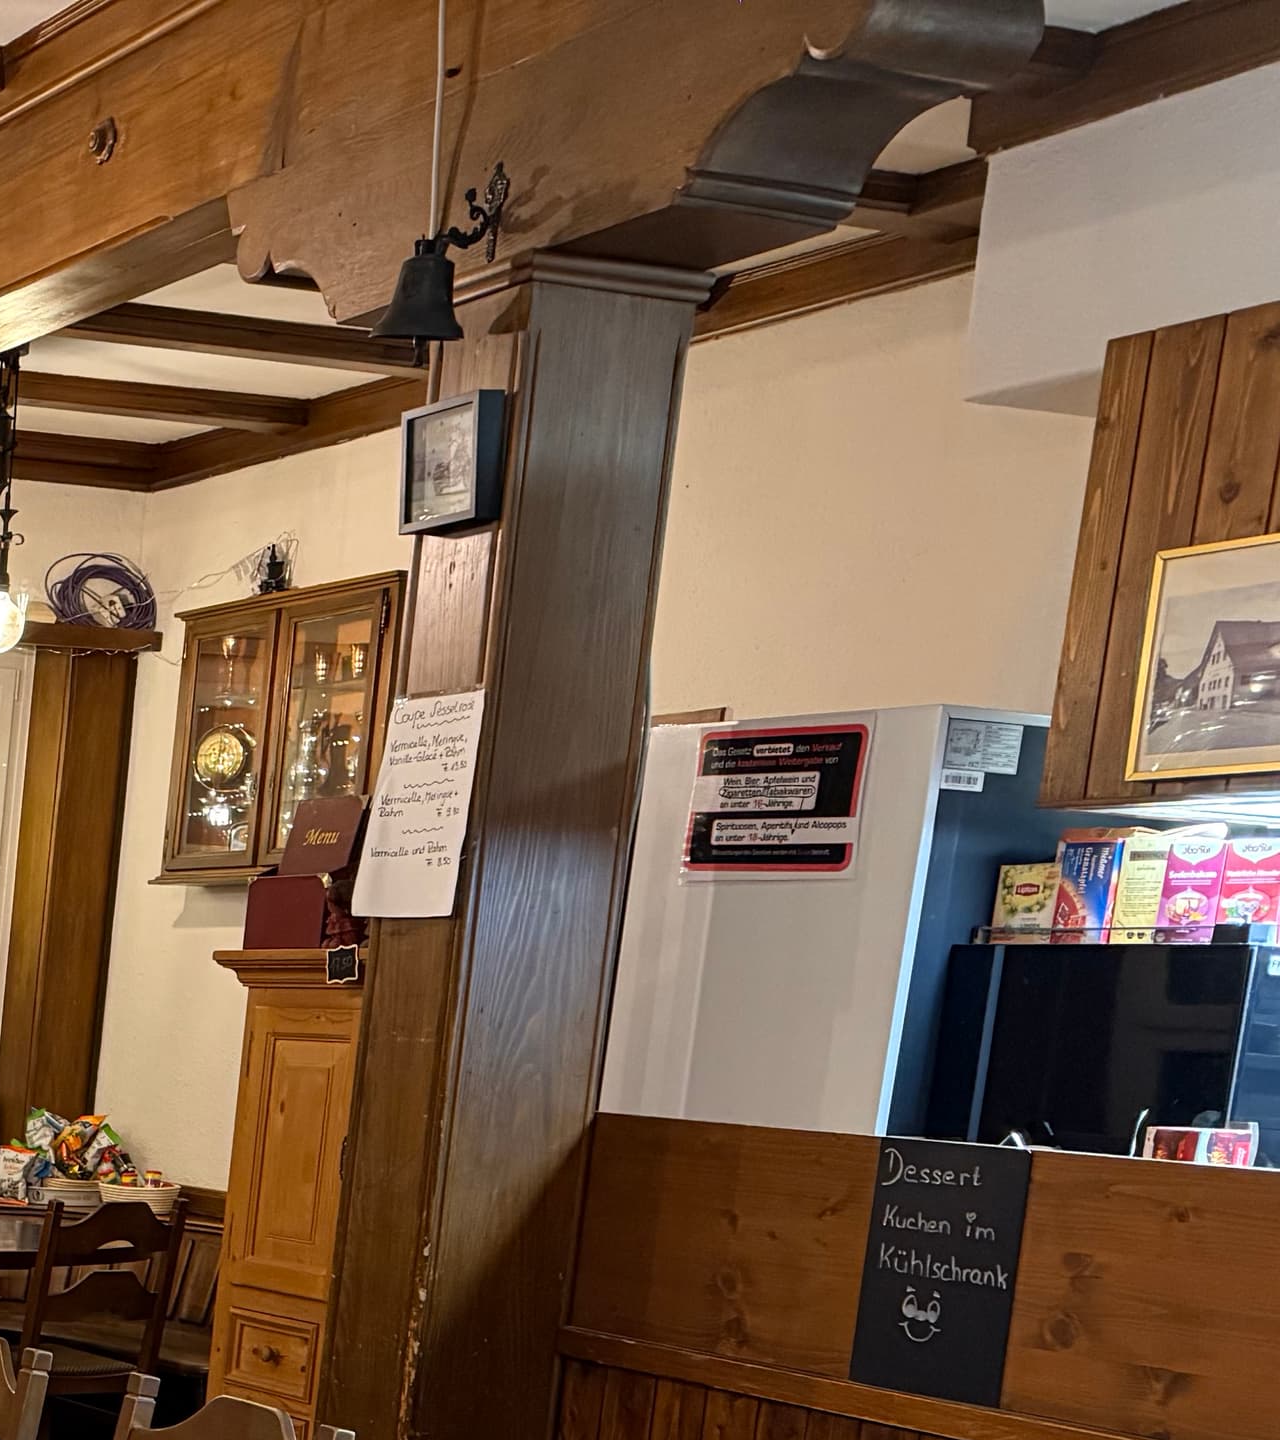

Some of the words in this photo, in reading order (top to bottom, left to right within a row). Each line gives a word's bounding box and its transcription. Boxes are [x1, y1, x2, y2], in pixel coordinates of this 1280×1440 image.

[393, 706, 425, 729] Coupe
[755, 745, 792, 755] verbietet
[795, 743, 810, 753] den
[825, 756, 840, 765] von
[801, 774, 817, 784] und
[378, 806, 404, 818] Rahm
[810, 819, 847, 832] Alcopops
[303, 828, 340, 846] Menu
[411, 845, 425, 855] und
[880, 1147, 983, 1188] Dessert
[882, 1203, 952, 1235] Kuchen
[965, 1211, 996, 1242] im
[878, 1242, 1010, 1291] Kühlschrank
